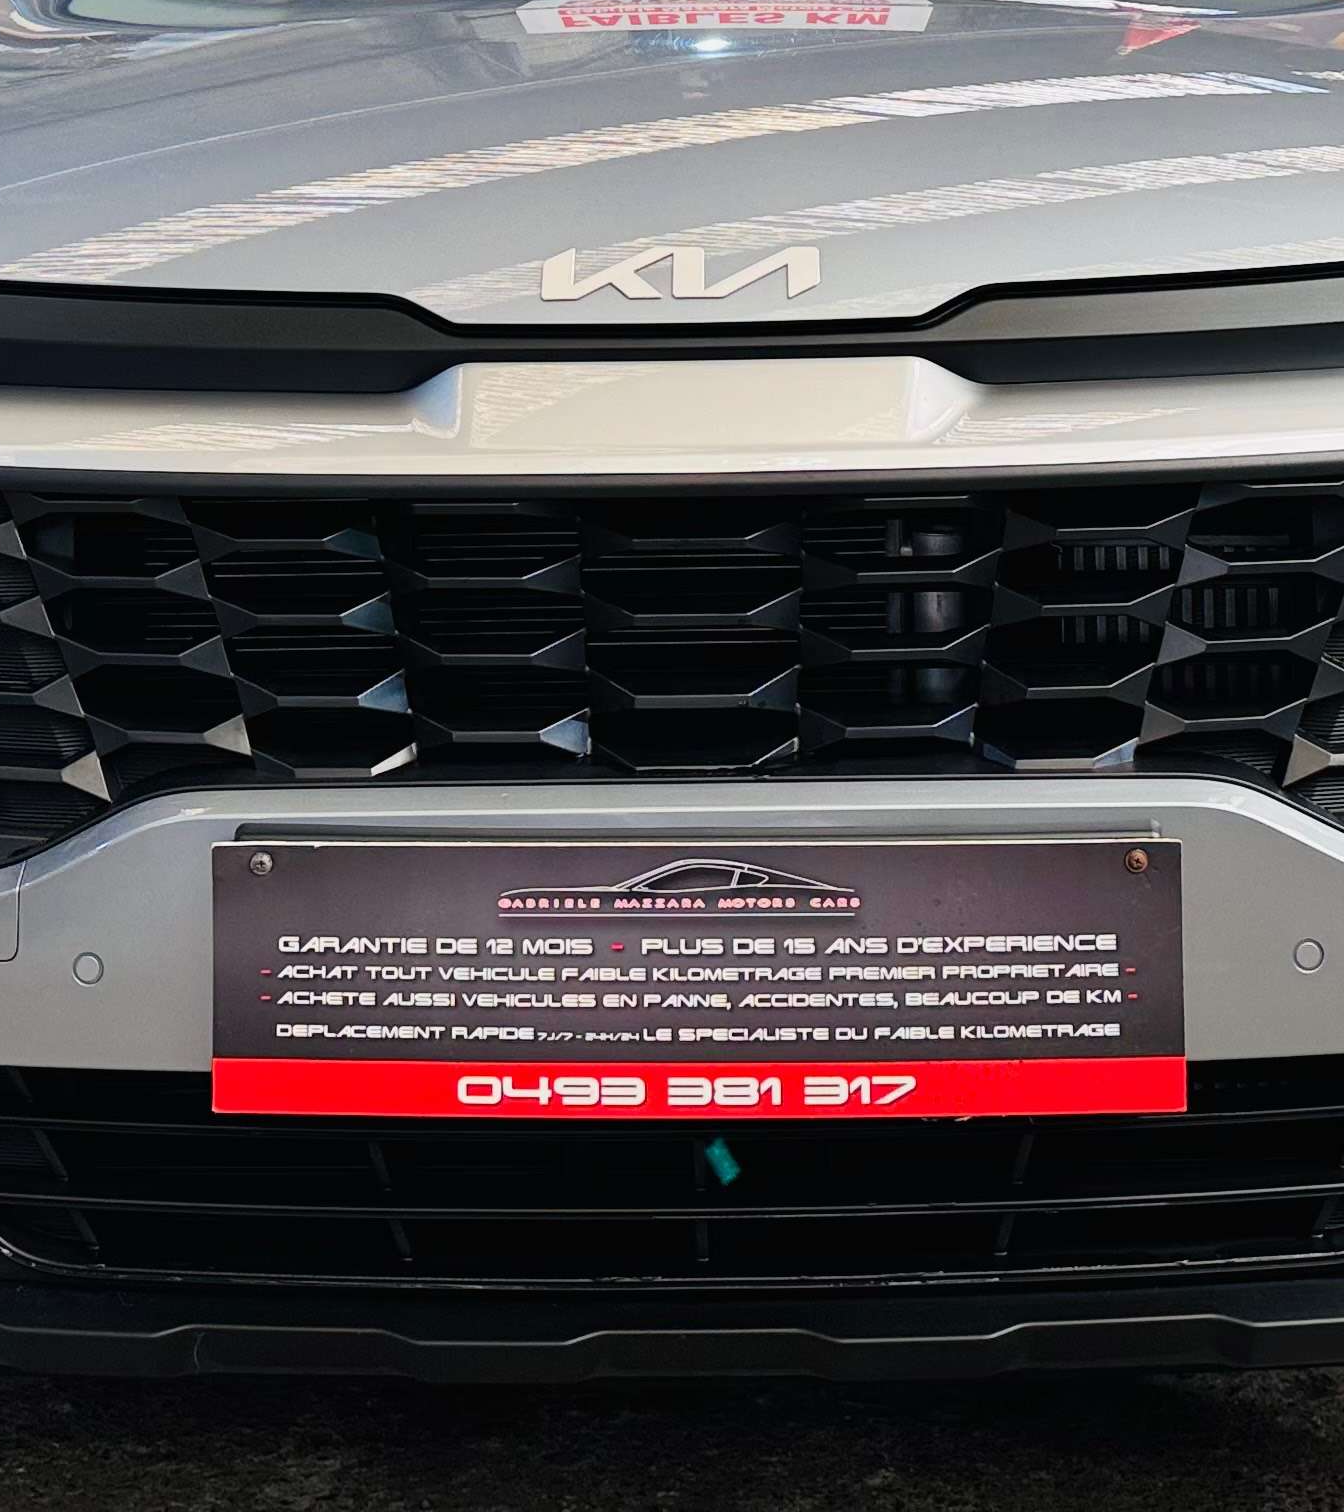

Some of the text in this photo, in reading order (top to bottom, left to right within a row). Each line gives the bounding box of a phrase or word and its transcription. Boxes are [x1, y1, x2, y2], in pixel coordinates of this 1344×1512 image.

[497, 896, 861, 909] GABRIELE MAZZARA MOTORS CARS
[278, 936, 428, 954] GARANTIE
[435, 937, 478, 955] DE
[485, 938, 514, 955] 12
[522, 938, 593, 955] MOIS
[641, 938, 724, 955] PLUS
[732, 938, 775, 955] DE
[783, 937, 816, 955] 15
[824, 937, 889, 954] ANS
[896, 933, 1117, 954] D'EXPERIENCE
[277, 965, 358, 980] ACHAT
[364, 966, 433, 980] TOUT
[438, 966, 555, 981] VEHICULE
[561, 967, 647, 982] FAIBLE
[652, 966, 822, 982] KILOMETRAGE
[828, 966, 936, 981] PREMIER
[942, 963, 1119, 980] PROPRIETAIRE
[276, 991, 376, 1006] ACHETE
[382, 992, 456, 1007] AUSSI
[461, 993, 597, 1008] VEHICULES
[602, 993, 638, 1008] EN
[643, 993, 732, 1010] PANNE,
[738, 992, 899, 1009] ACCIDENTES,
[905, 990, 1040, 1006] BEAUCOUP
[1046, 990, 1081, 1004] DE
[1086, 989, 1122, 1004] KM
[276, 1023, 446, 1040] DEPLACEMENT
[451, 1026, 535, 1040] RAPIDE
[642, 1028, 672, 1042] LE
[678, 1027, 829, 1042] SPECIALISTE
[835, 1027, 868, 1041] DU
[874, 1026, 955, 1040] FAIBLE
[960, 1023, 1121, 1039] KILOMETRAGE
[457, 1075, 917, 1106] 0493 381 317
